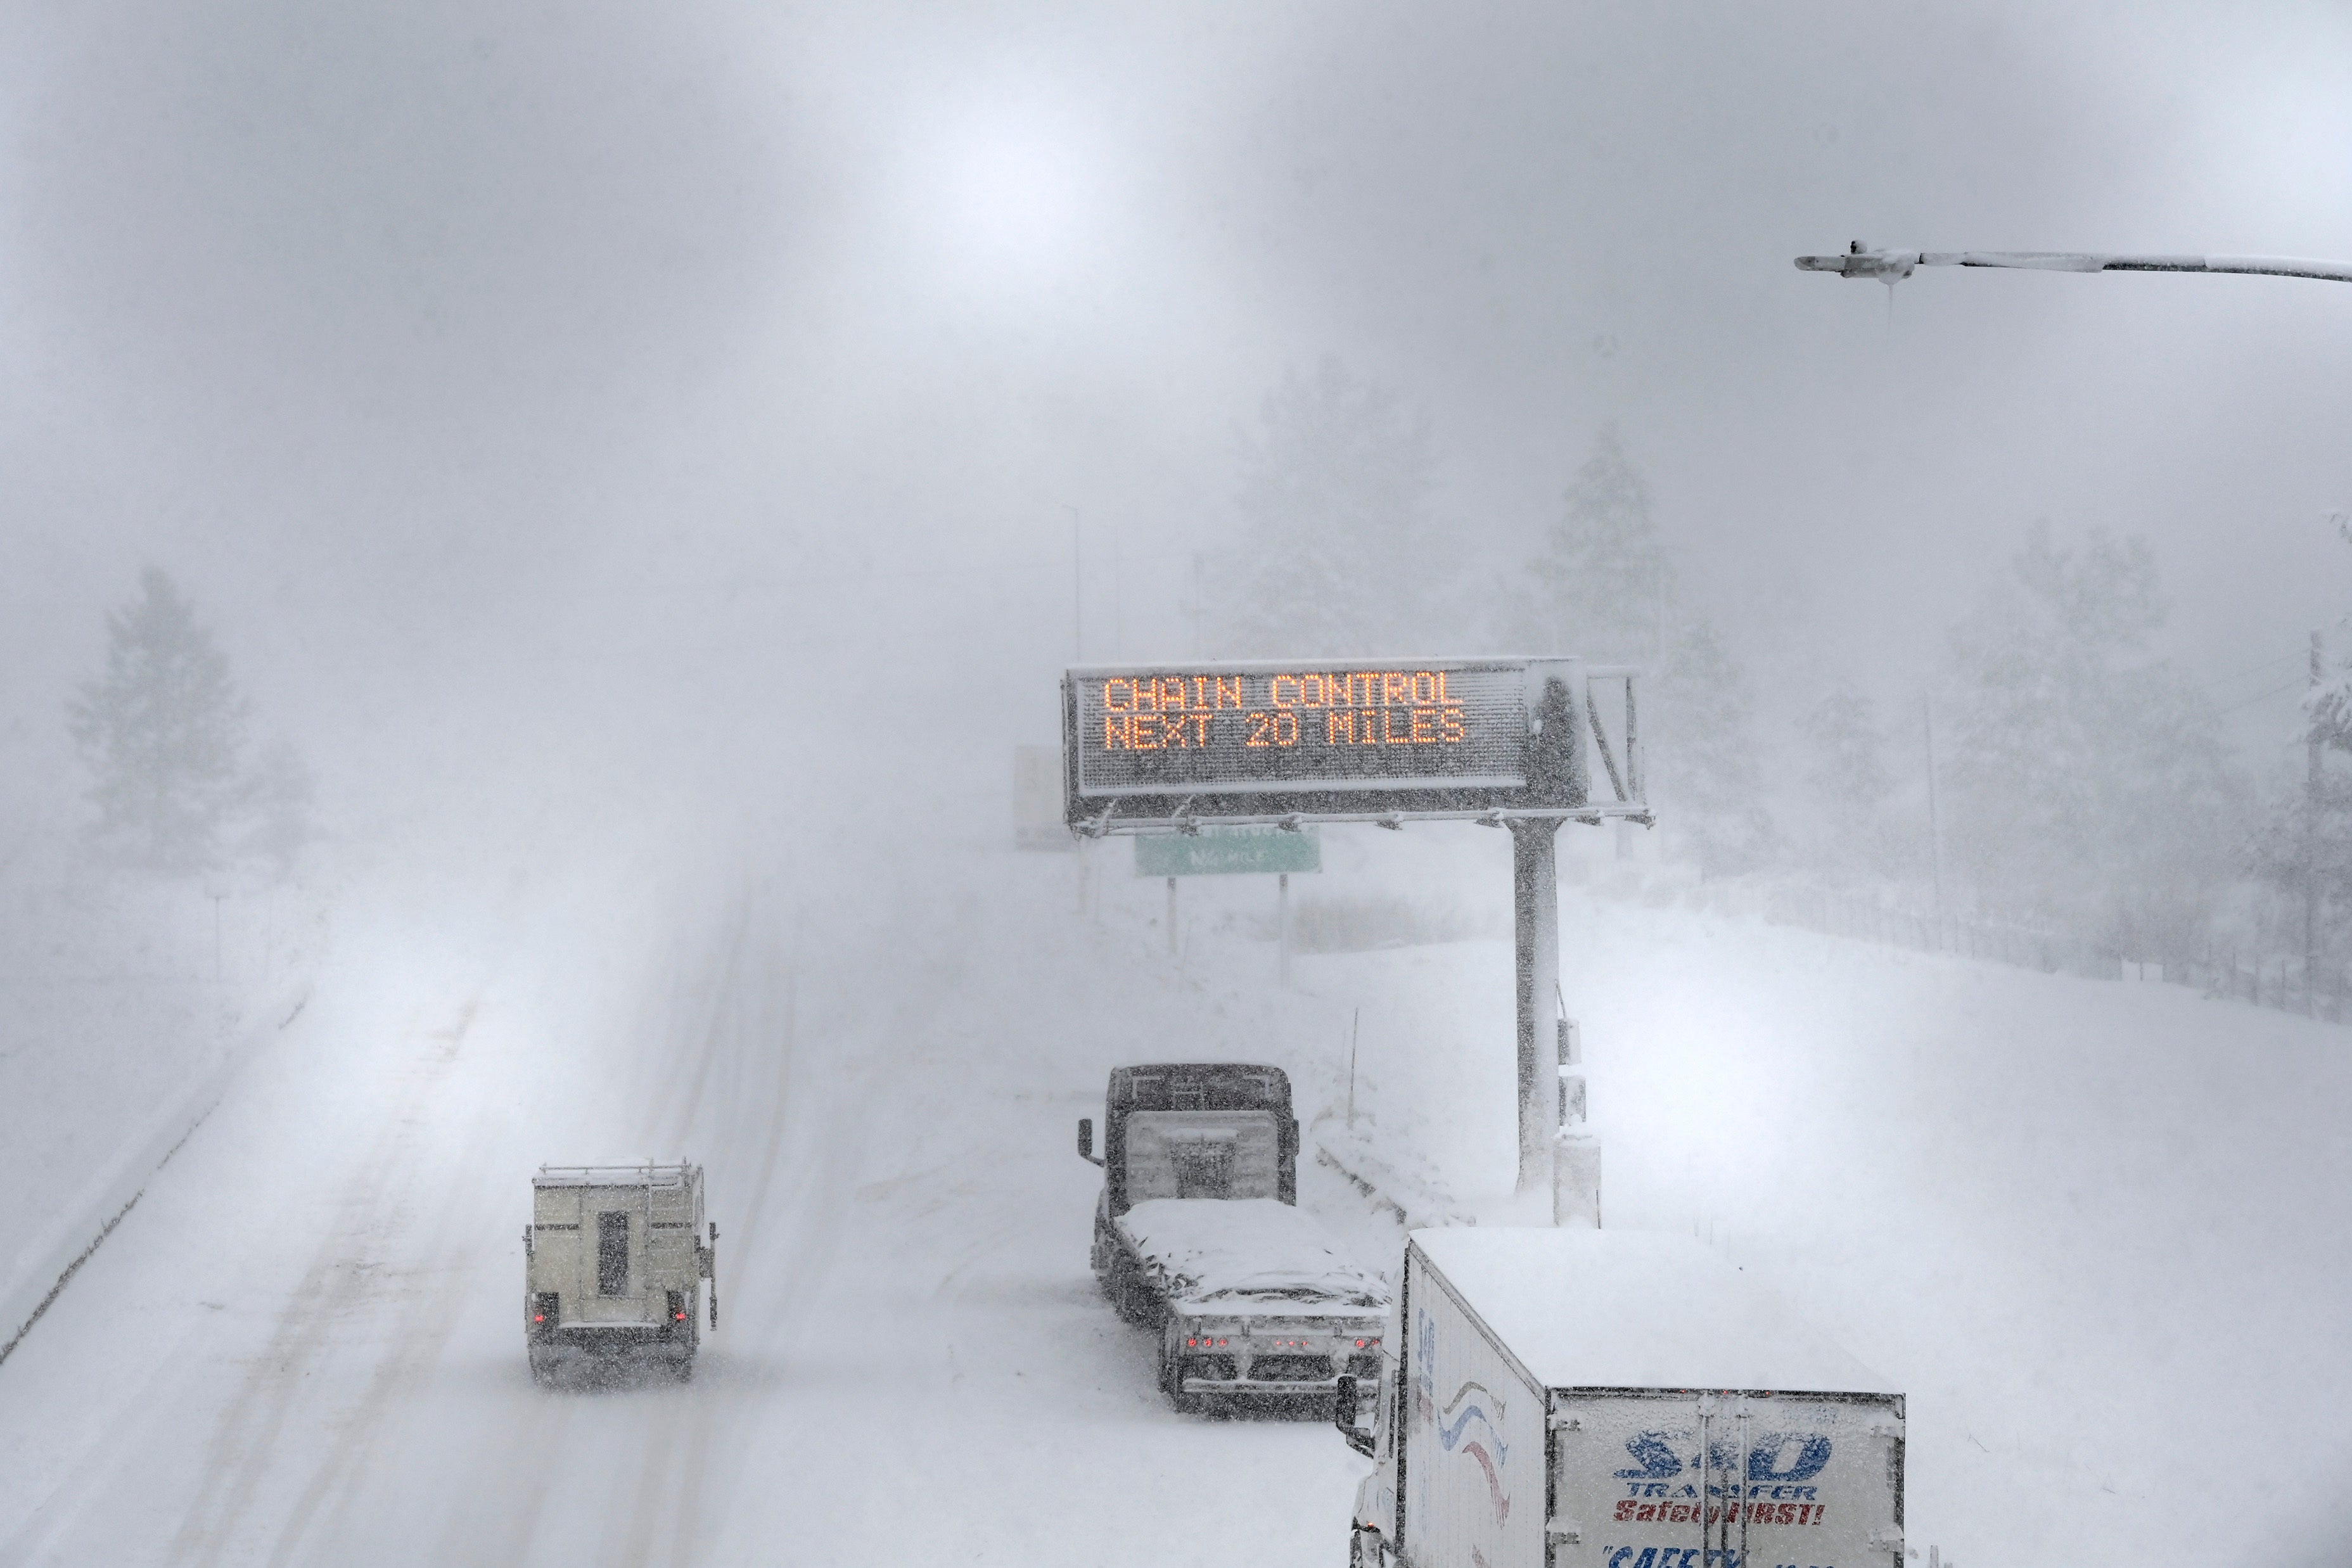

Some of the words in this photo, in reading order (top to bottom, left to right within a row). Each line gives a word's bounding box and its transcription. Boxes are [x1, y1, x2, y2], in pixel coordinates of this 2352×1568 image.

[1105, 676, 1242, 711] CHAIN
[1272, 672, 1464, 708] CONTROL
[1105, 714, 1213, 749] NEXT
[1245, 712, 1298, 746] 20
[1329, 708, 1465, 744] MILES
[1626, 1482, 1818, 1500] TRANSFER
[1613, 1499, 1721, 1526] Safety
[1726, 1501, 1825, 1526] FIRST!
